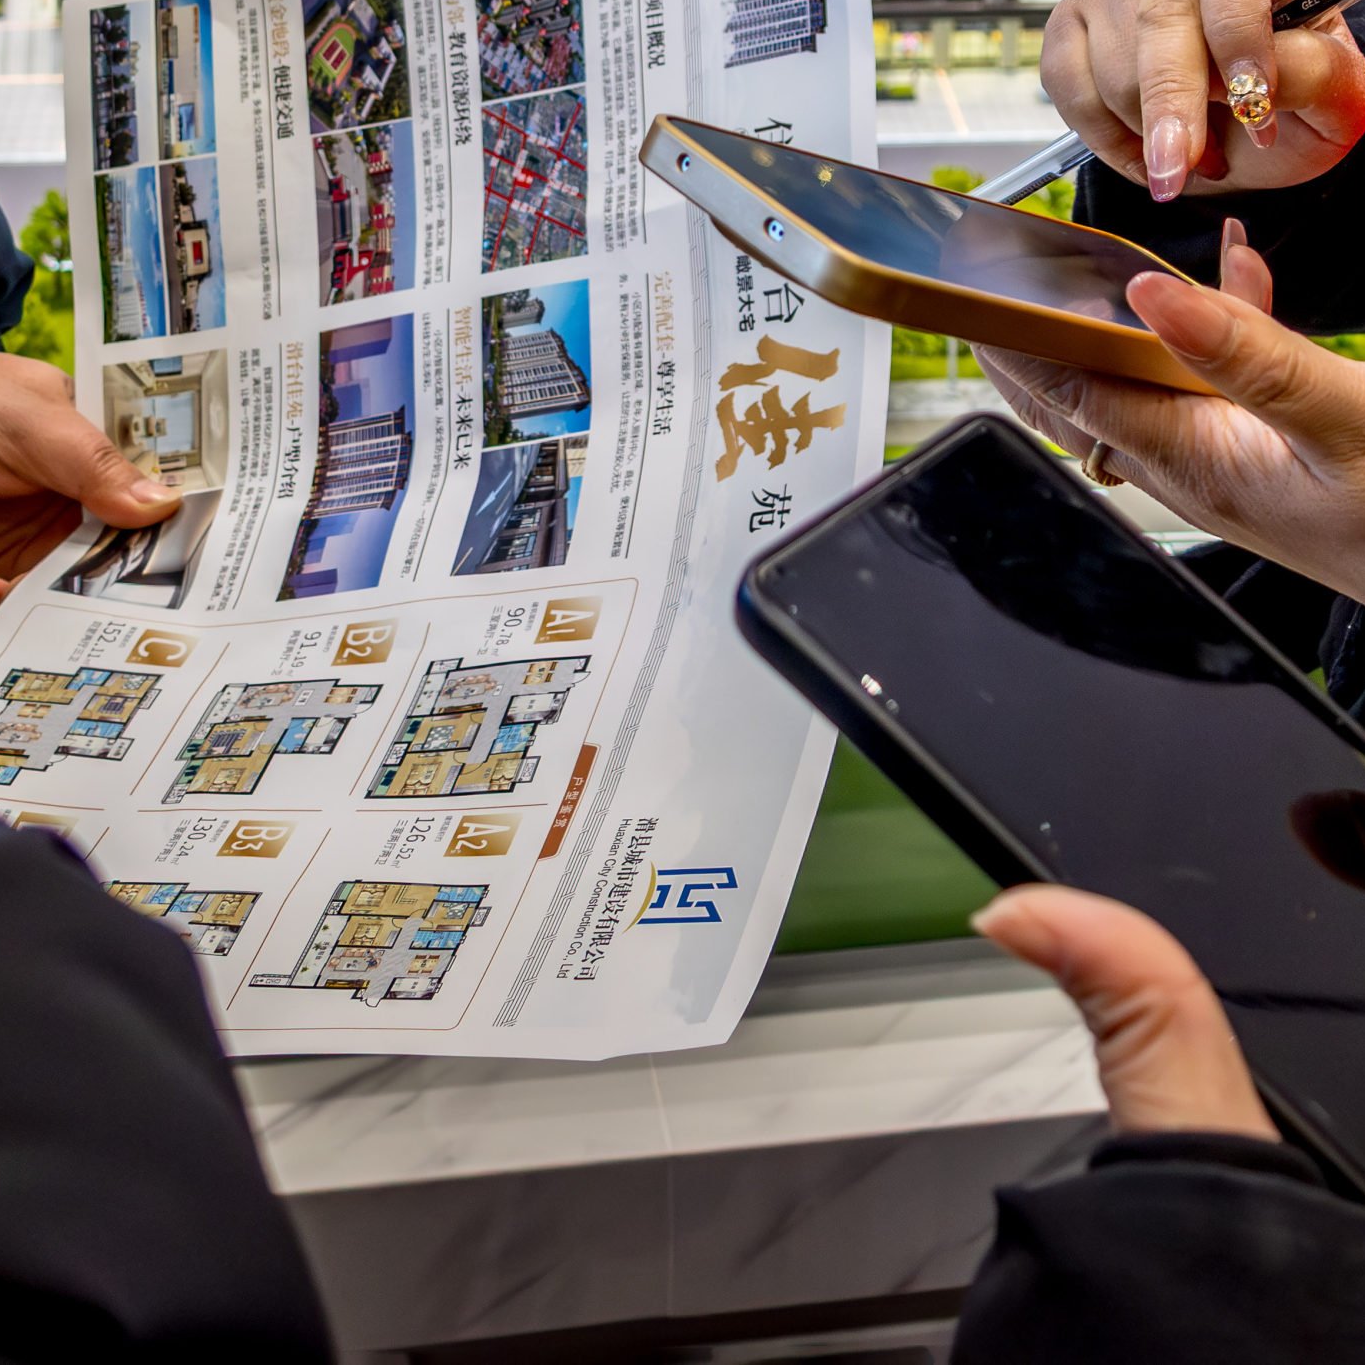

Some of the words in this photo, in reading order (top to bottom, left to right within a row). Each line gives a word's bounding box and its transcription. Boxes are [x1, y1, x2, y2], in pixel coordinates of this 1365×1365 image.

[652, 271, 677, 436] 完善配套-尊享生活
[452, 306, 477, 471] 智能生活-未来已来
[137, 637, 188, 661] C
[341, 624, 393, 659] B2
[154, 817, 193, 864] 三室两厅两卫
[231, 825, 291, 851] B3
[374, 818, 410, 866] 三室两厅两卫
[456, 822, 511, 850] A2
[607, 818, 633, 857] Huaxian
[597, 858, 617, 878] City
[573, 817, 660, 982] 滑县城市建设有限公司
[573, 879, 609, 940] Construction
[562, 940, 583, 961] Co.,
[555, 962, 576, 980] Ltd
